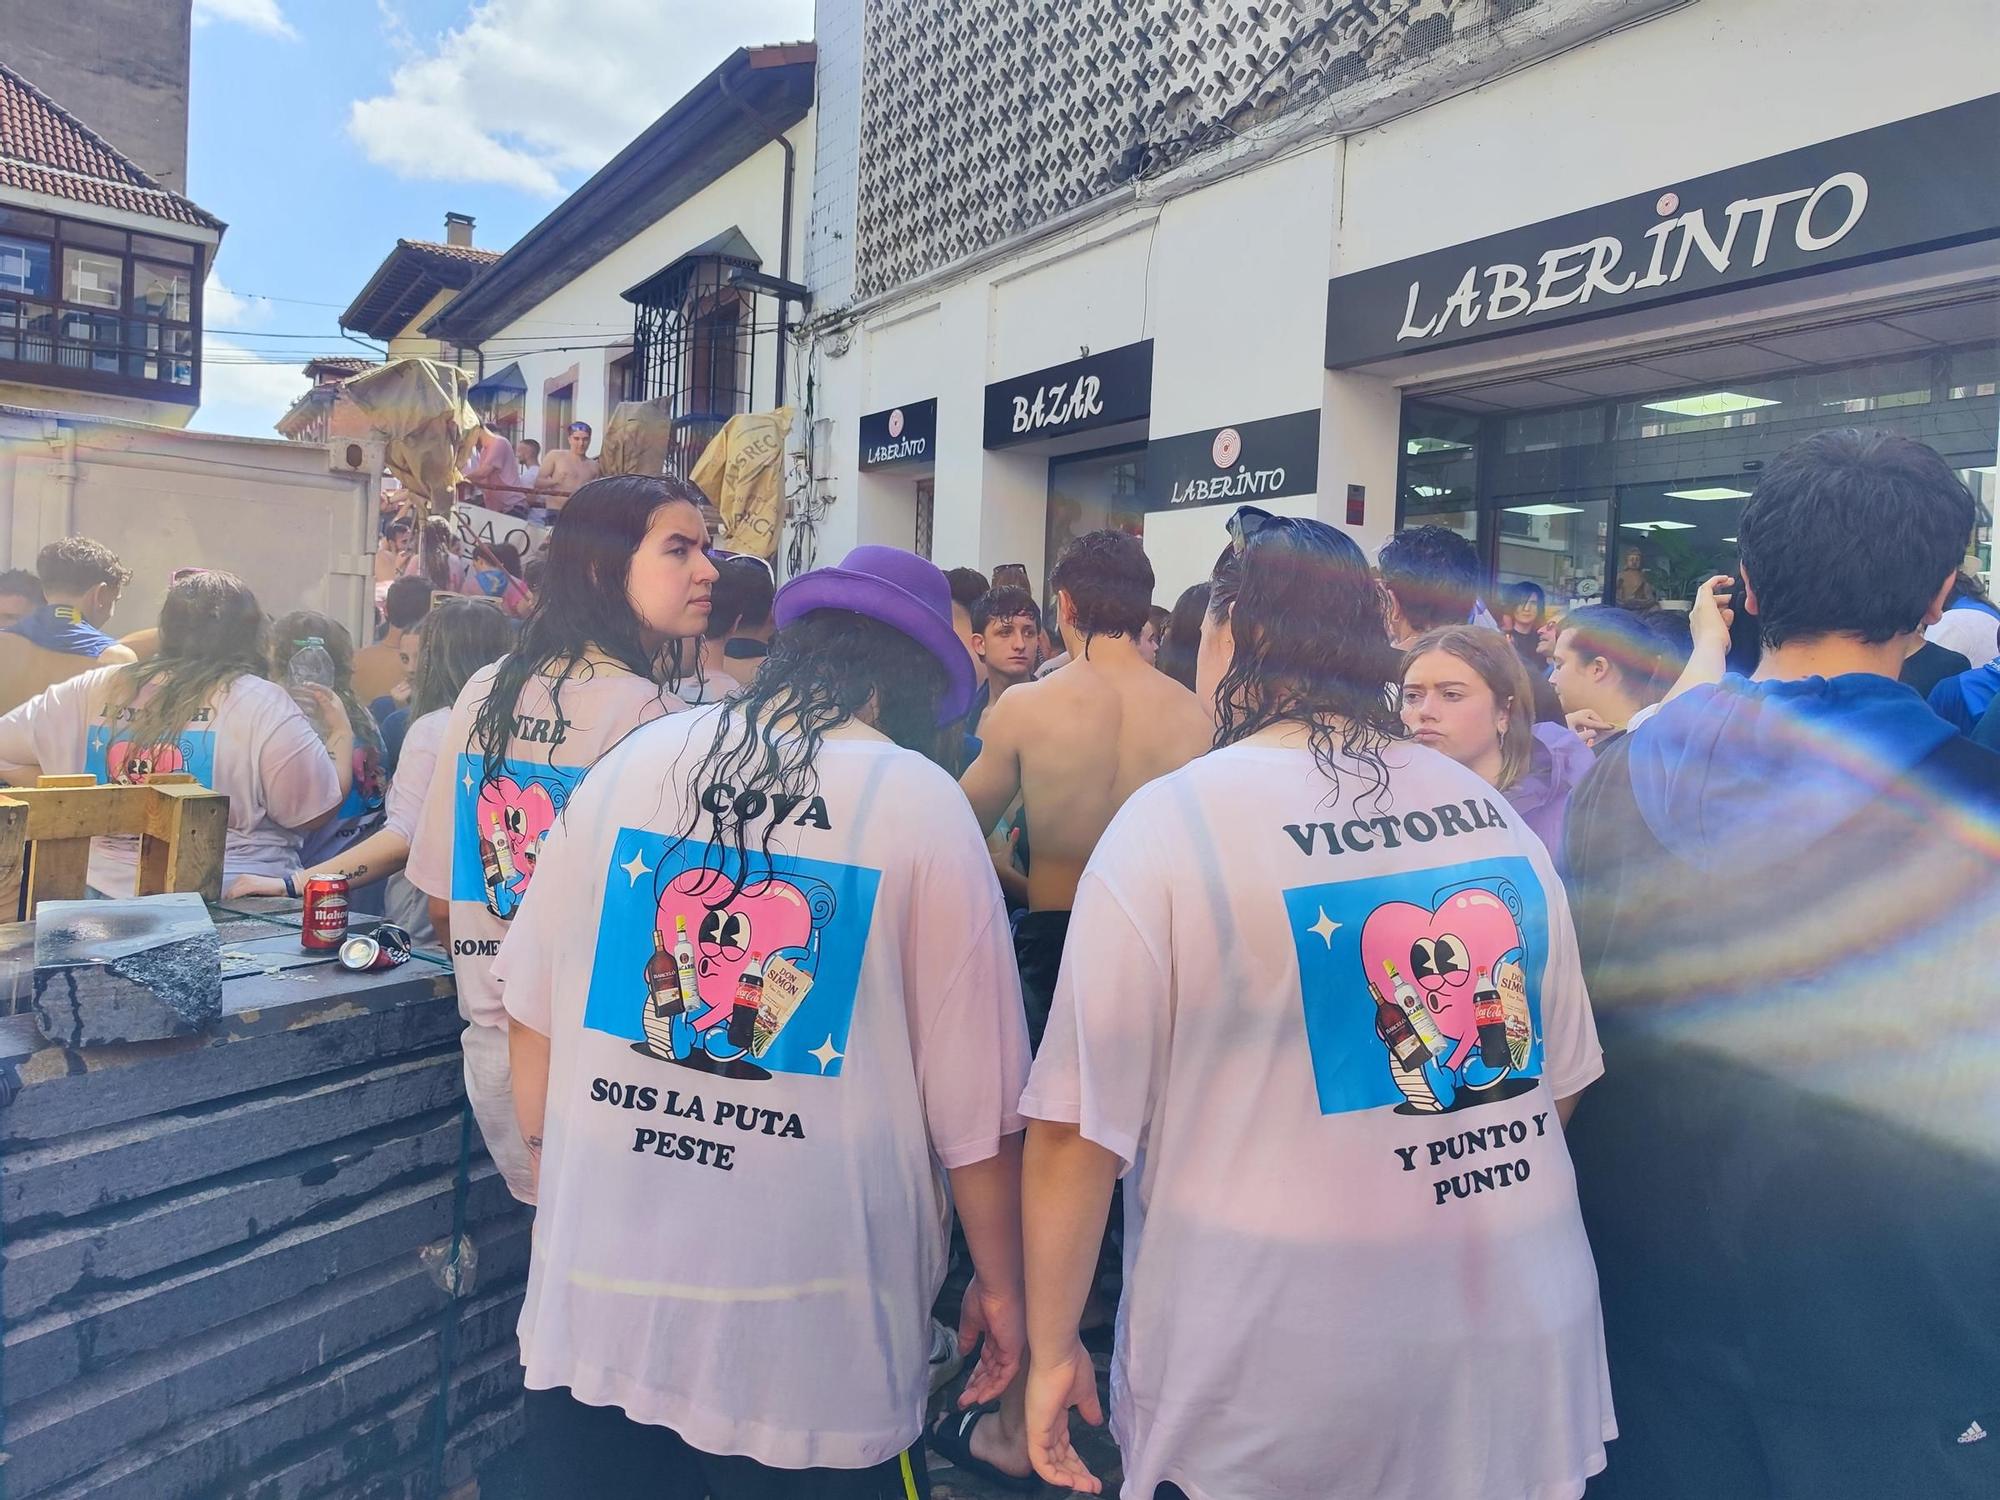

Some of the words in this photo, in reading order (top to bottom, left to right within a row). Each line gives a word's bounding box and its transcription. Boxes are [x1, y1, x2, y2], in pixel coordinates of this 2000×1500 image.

[1396, 171, 1870, 342] LABERINTO
[1012, 375, 1104, 433] BAZAR
[867, 435, 926, 464] LABERINTO
[1170, 464, 1286, 504] LABERINTO
[1282, 798, 1508, 856] VICTORIA
[454, 939, 502, 956] SOME
[779, 967, 798, 982] DON
[591, 1077, 658, 1111] SOIS
[663, 1090, 705, 1122] LA
[713, 1100, 806, 1139] PUTA
[632, 1127, 736, 1171] PESTE
[1394, 1145, 1418, 1171] Y
[1426, 1120, 1527, 1166] PUNTO
[1532, 1112, 1548, 1136] Y
[1433, 1158, 1531, 1205] PUNTO
